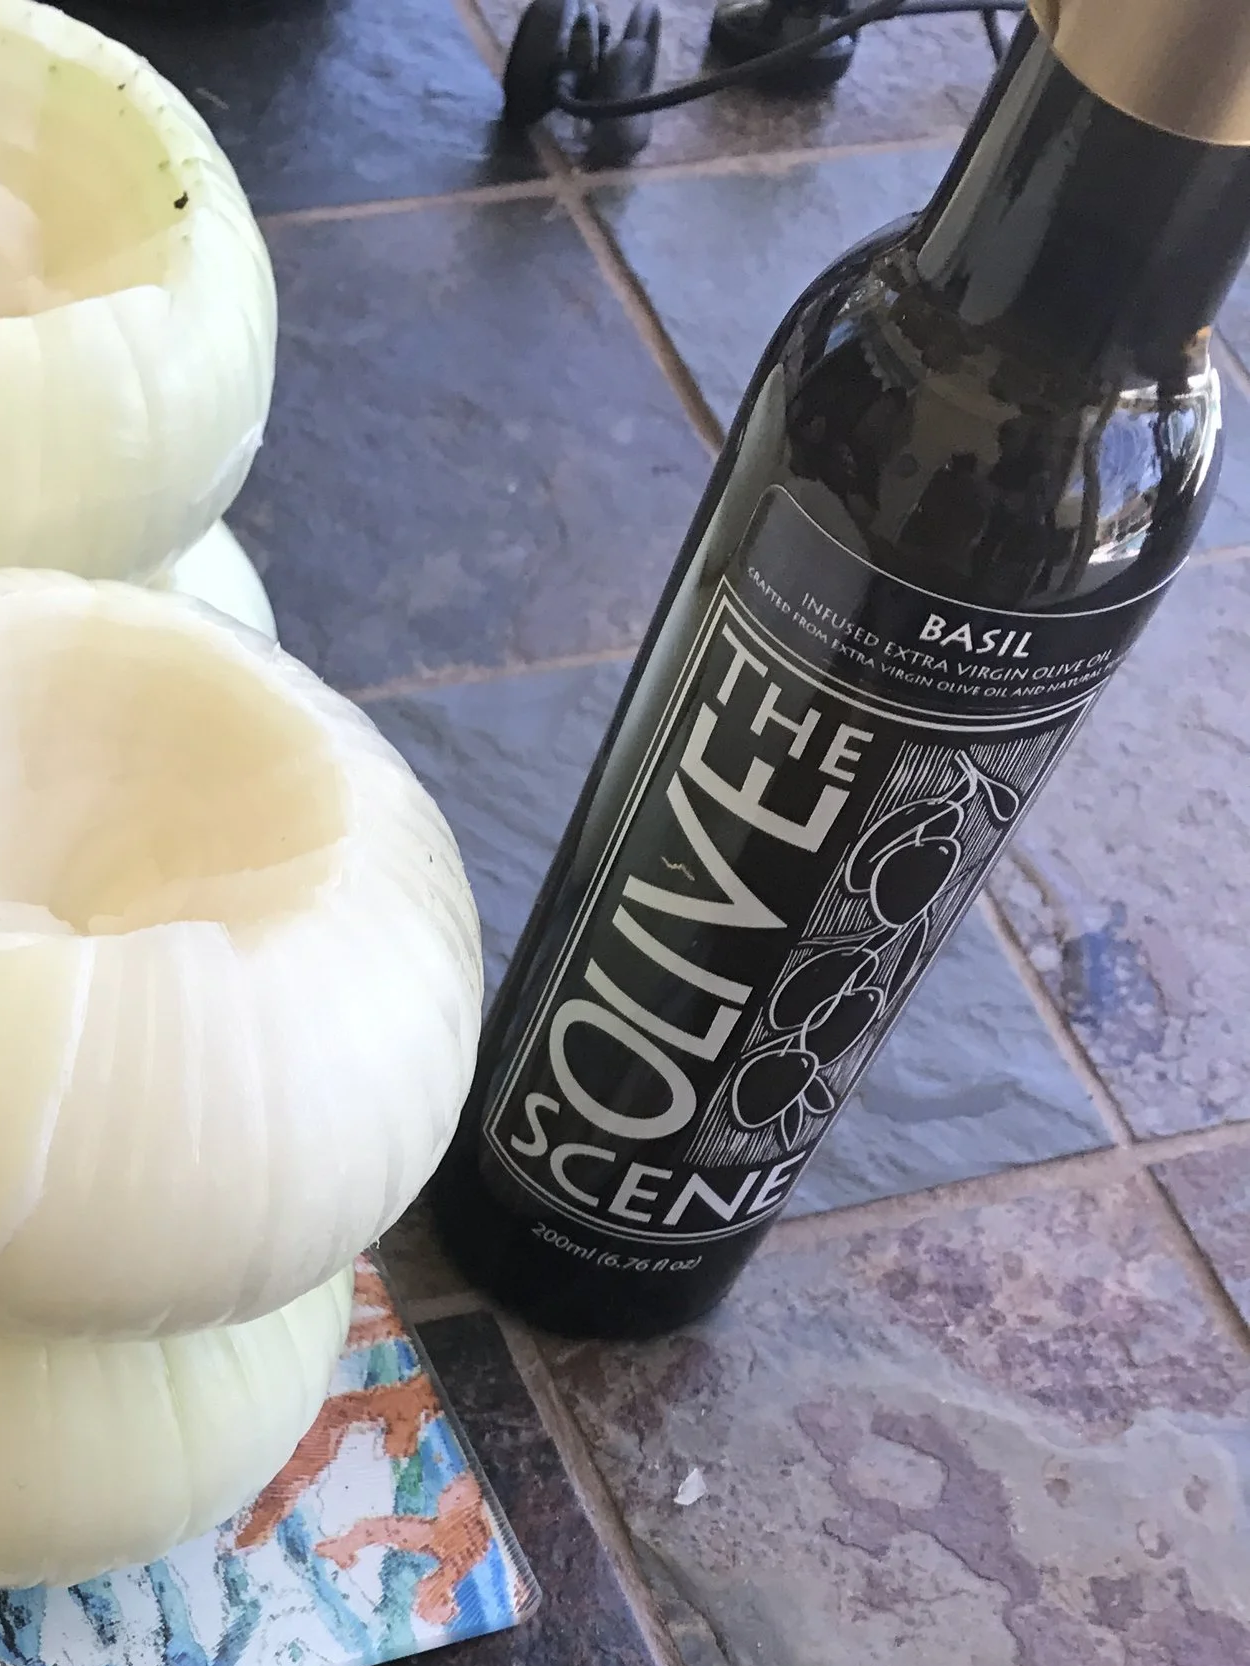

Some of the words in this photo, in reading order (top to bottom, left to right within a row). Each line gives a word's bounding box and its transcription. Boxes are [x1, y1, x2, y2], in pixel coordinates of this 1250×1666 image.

[748, 567, 791, 614] CRAFTED
[792, 612, 828, 644] FROM
[831, 638, 875, 668] EXTRA
[881, 662, 933, 690] VIRGIN
[937, 680, 981, 696] OLIVE
[983, 687, 1008, 698] OIL
[1010, 686, 1045, 697] AND
[1049, 667, 1102, 692] NATURAL
[802, 593, 879, 647] INFUSED
[884, 641, 948, 673] EXTRA
[957, 662, 1029, 681] VIRGIN
[1032, 658, 1086, 680] OLIVE
[1087, 649, 1112, 668] OIL
[919, 613, 1032, 658] BASIL
[717, 622, 874, 782] THE
[549, 702, 850, 1139] OLIVE
[510, 1091, 807, 1226] SCENE
[531, 1222, 597, 1260] 200ml
